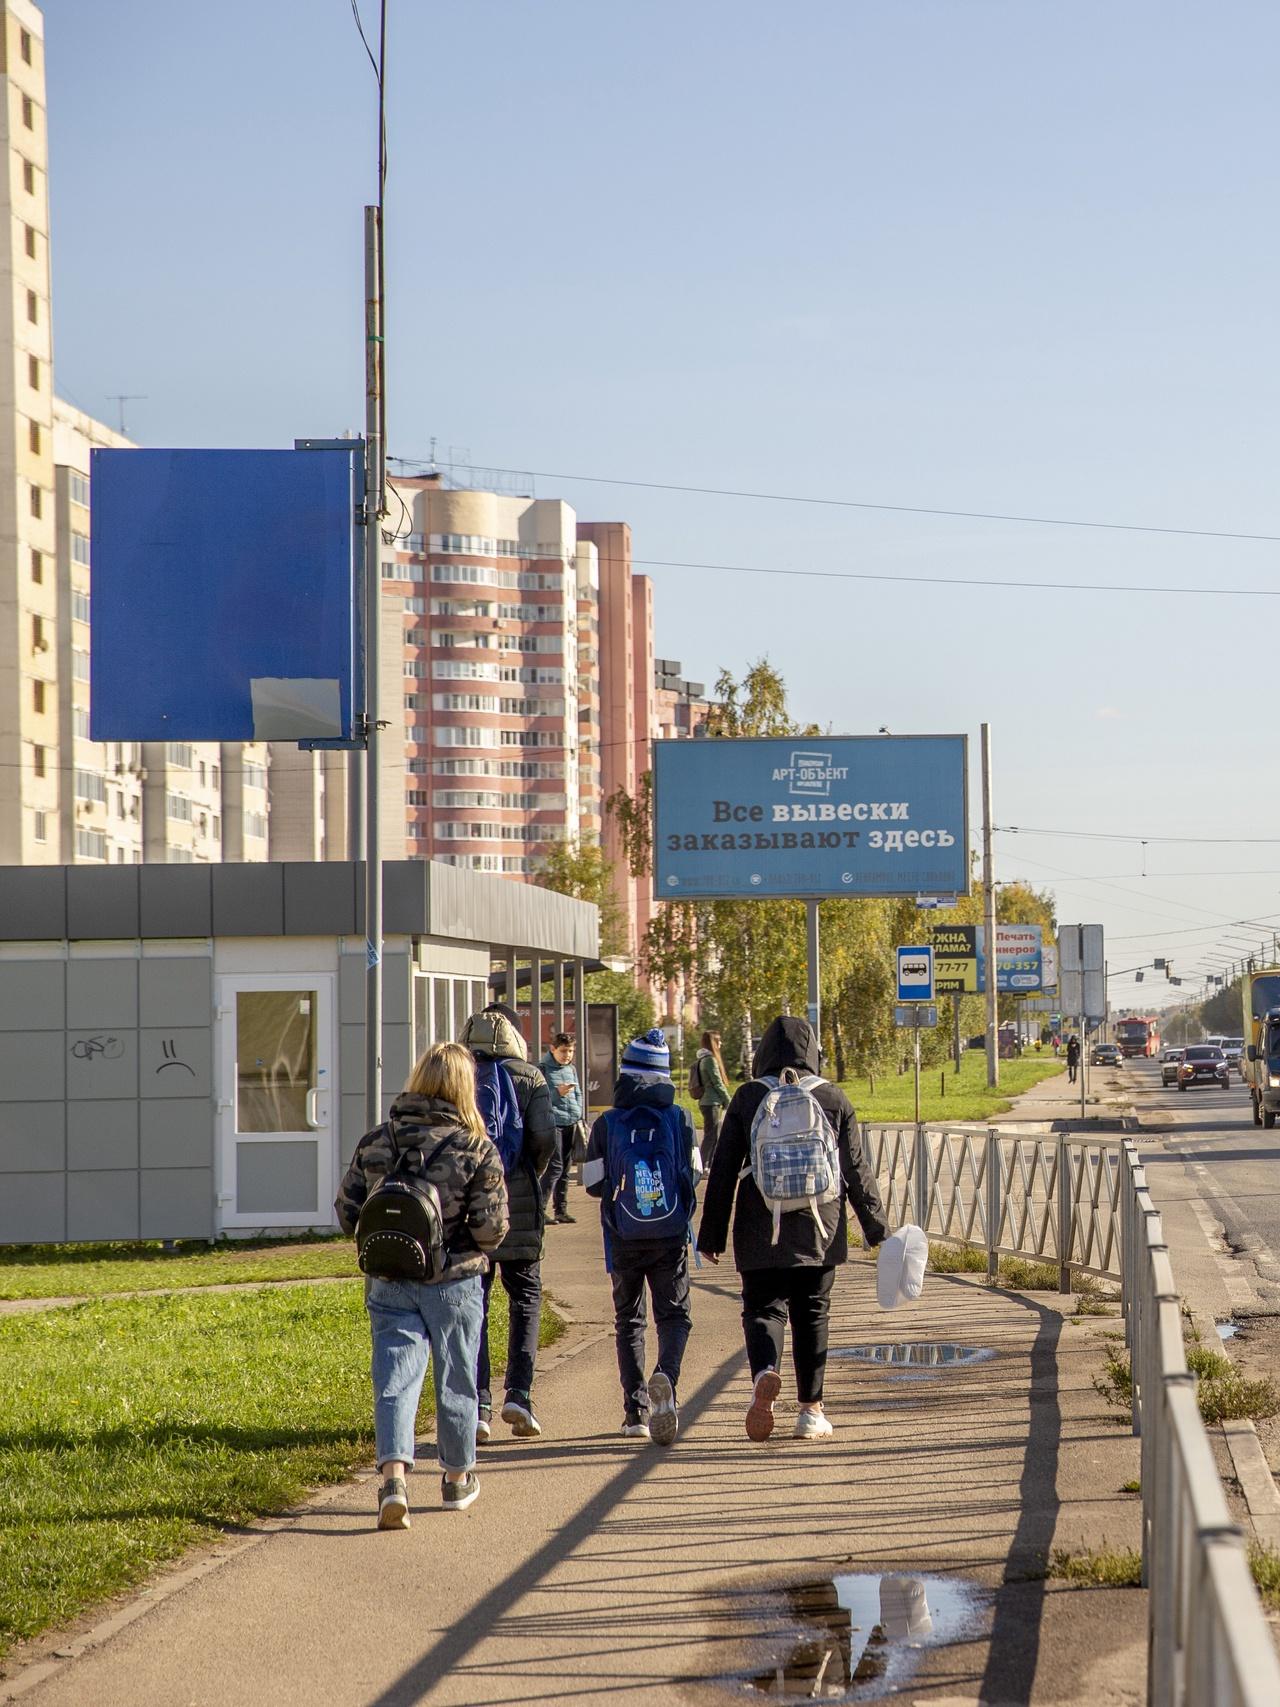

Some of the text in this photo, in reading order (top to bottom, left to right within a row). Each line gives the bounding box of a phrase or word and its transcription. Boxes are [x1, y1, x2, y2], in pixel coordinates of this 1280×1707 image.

[772, 767, 849, 781] АРТ-ОБЪЕКТ
[712, 800, 910, 822] Все вывески
[667, 829, 956, 852] заказывают здесь
[928, 933, 967, 943] УЖНА
[996, 932, 1036, 941] Печать
[933, 944, 971, 953] ЛАМА?
[934, 962, 969, 973] -77-77
[996, 961, 1039, 970] 70-357
